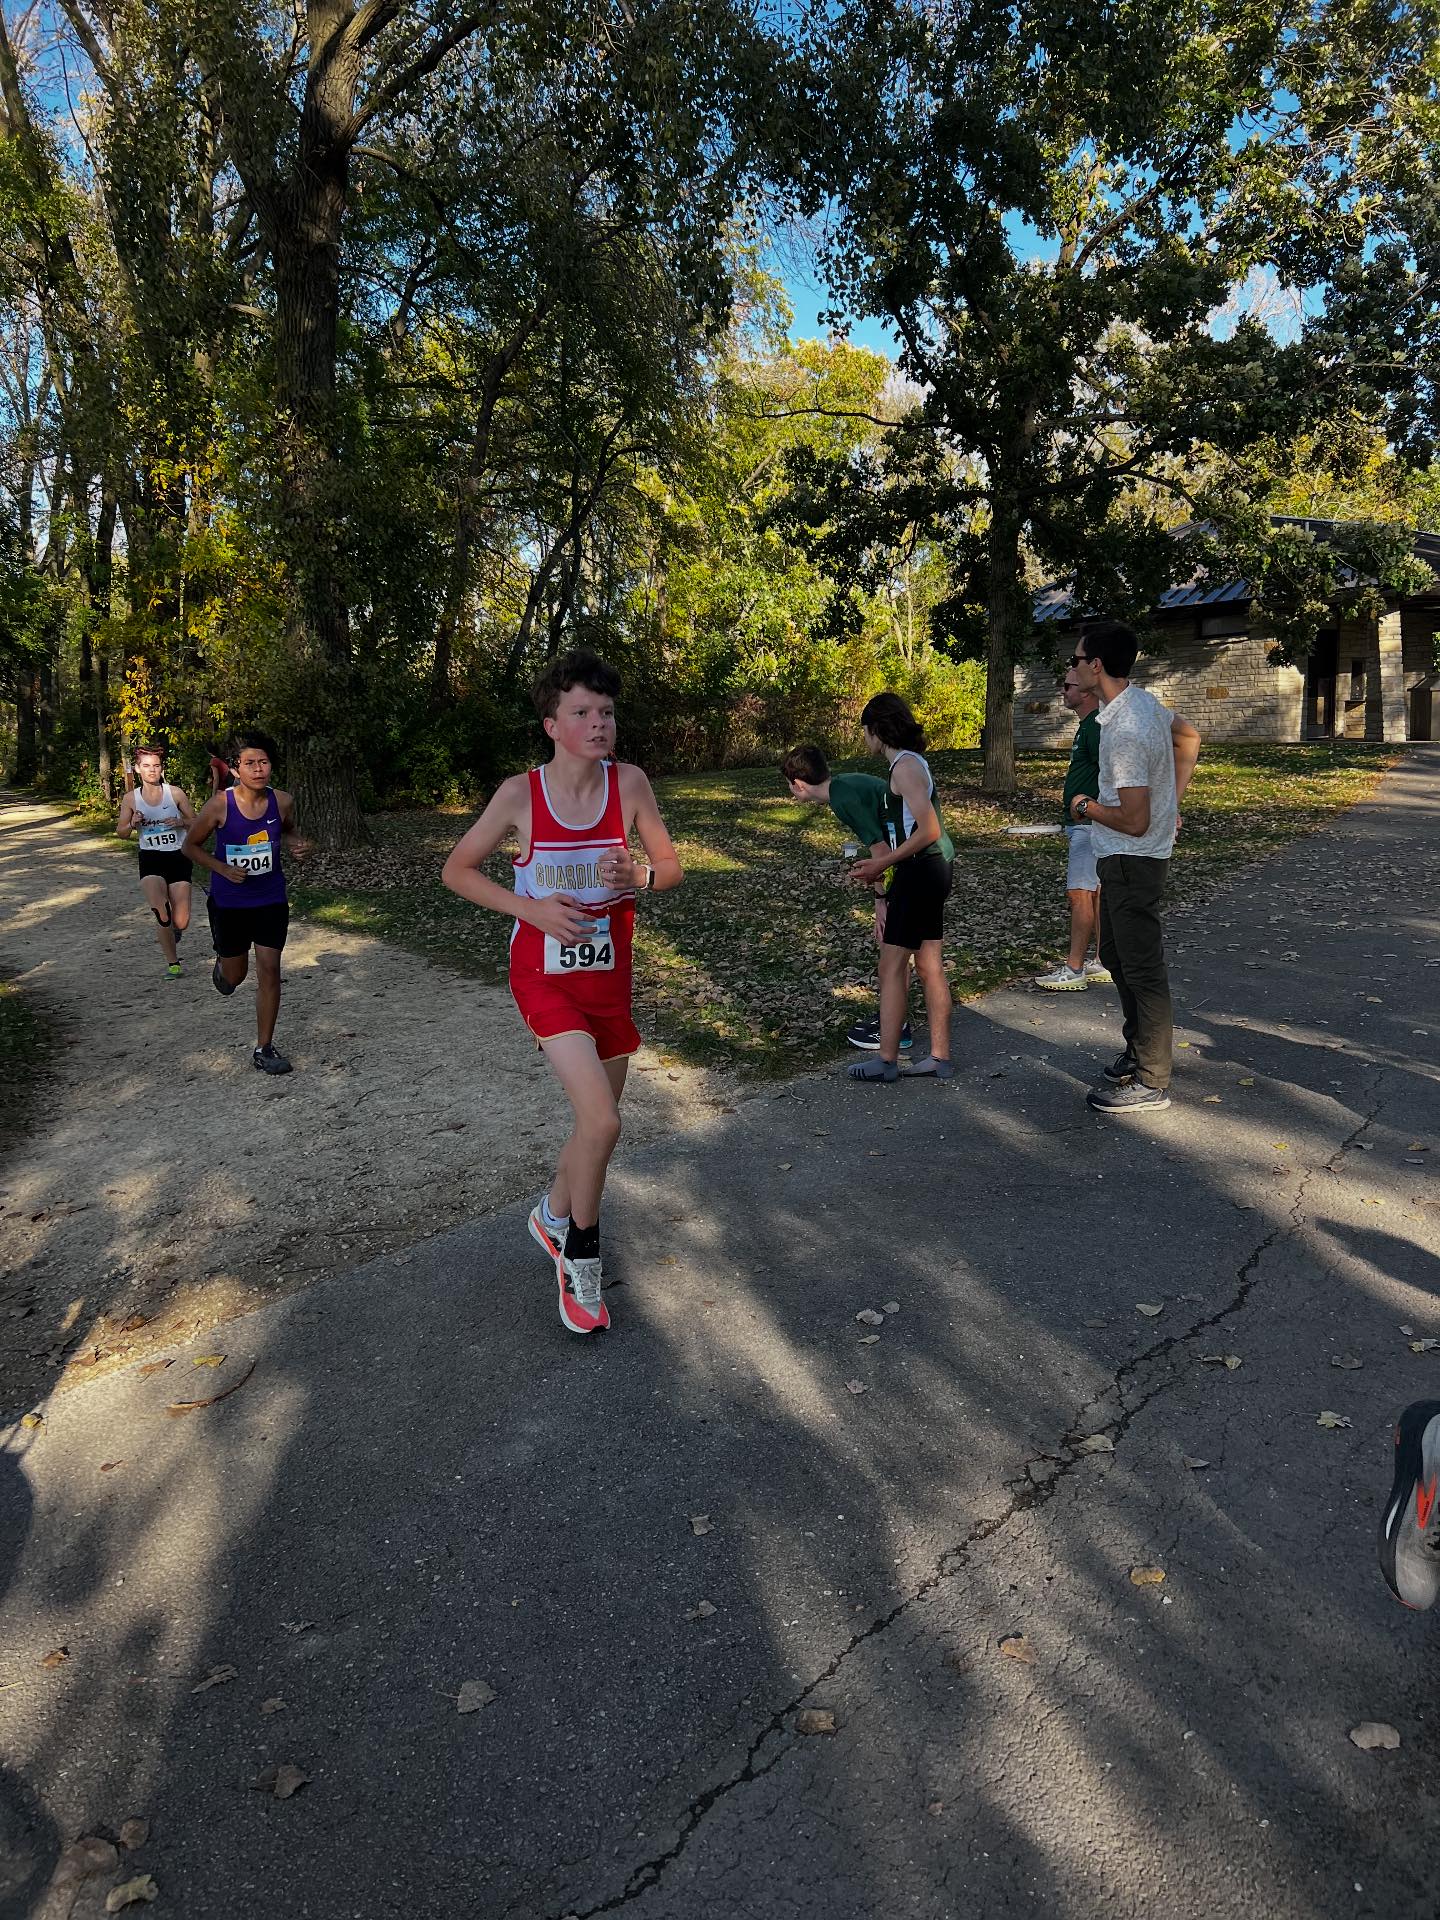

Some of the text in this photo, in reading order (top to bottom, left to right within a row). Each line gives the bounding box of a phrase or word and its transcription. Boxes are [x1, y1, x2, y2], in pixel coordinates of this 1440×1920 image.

[147, 833, 176, 846] 1159
[231, 856, 270, 871] 1204
[536, 863, 605, 889] GUARDIA
[559, 943, 611, 968] 594
